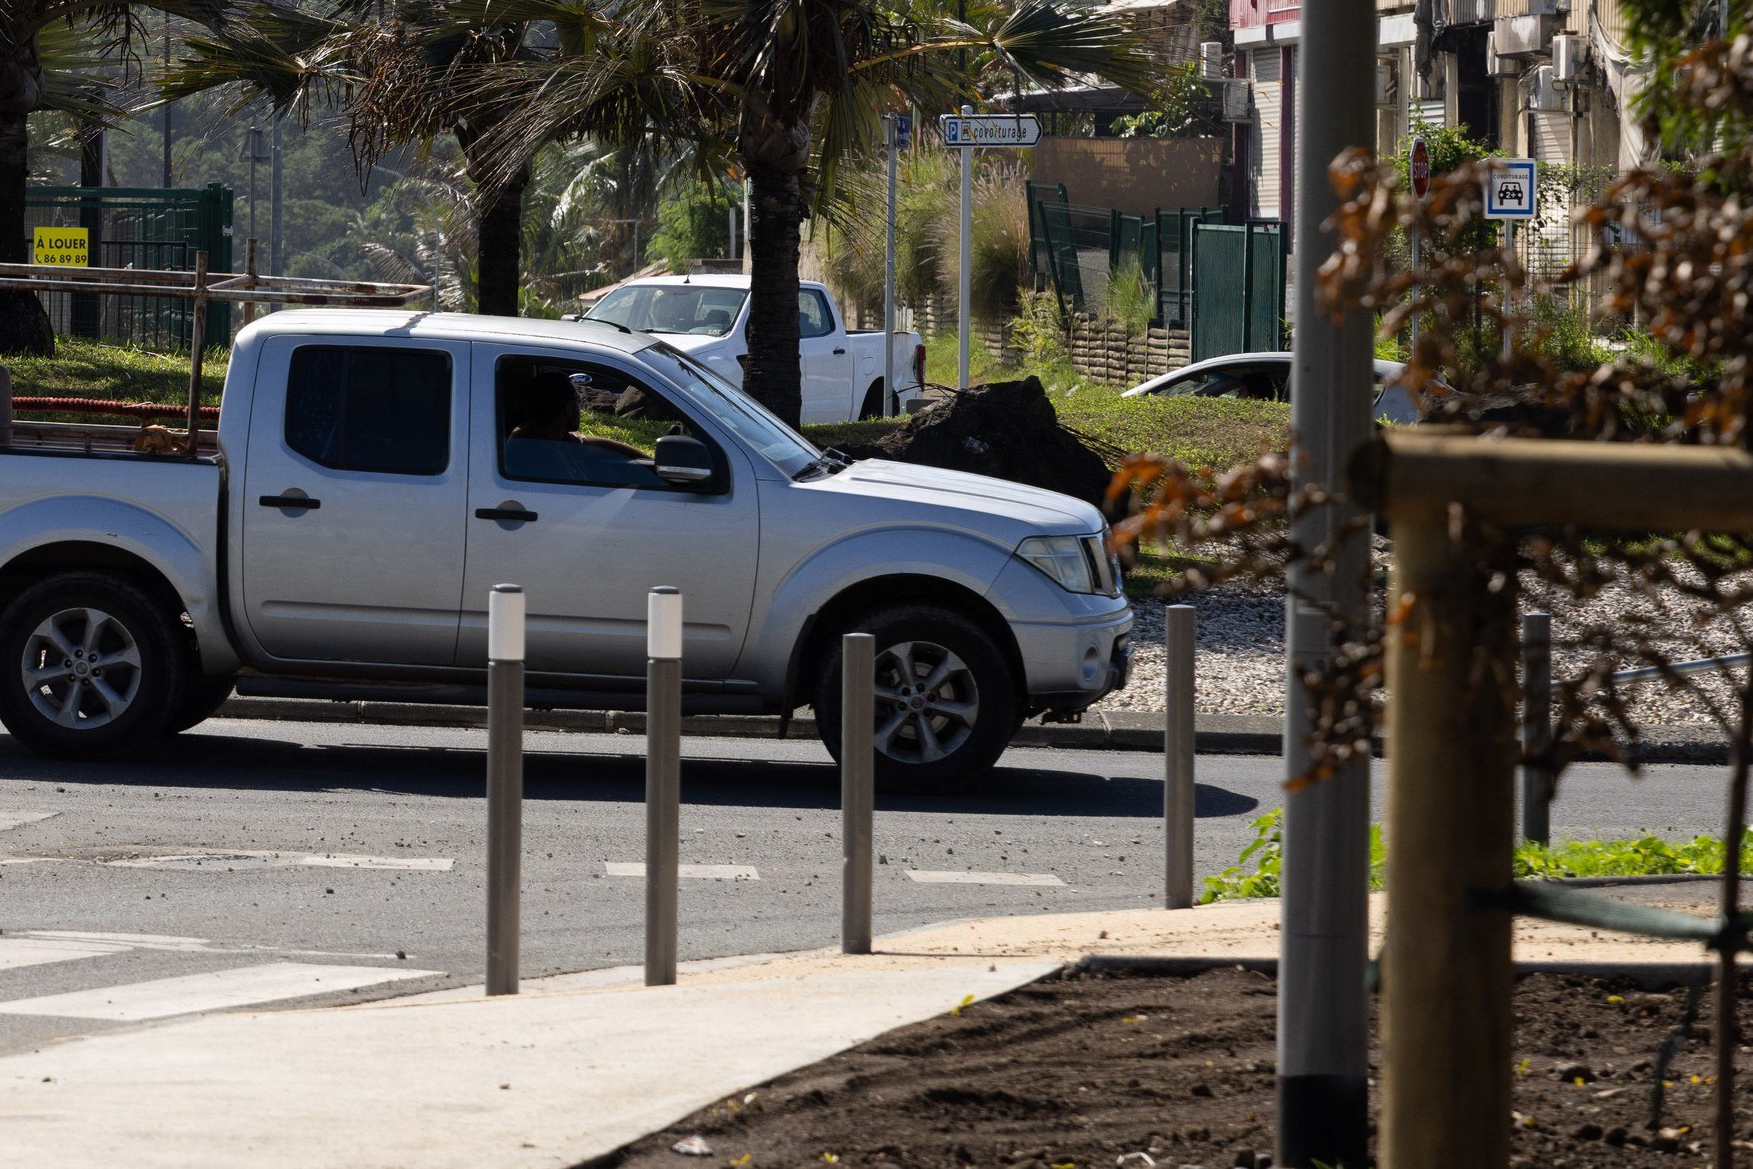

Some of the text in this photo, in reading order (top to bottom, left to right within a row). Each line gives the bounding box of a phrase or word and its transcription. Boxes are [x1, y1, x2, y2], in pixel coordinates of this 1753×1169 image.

[973, 124, 1027, 142] covoiturage
[1413, 161, 1428, 179] STOP
[36, 235, 86, 250] À LOUER
[43, 254, 87, 264] 86 89 89
